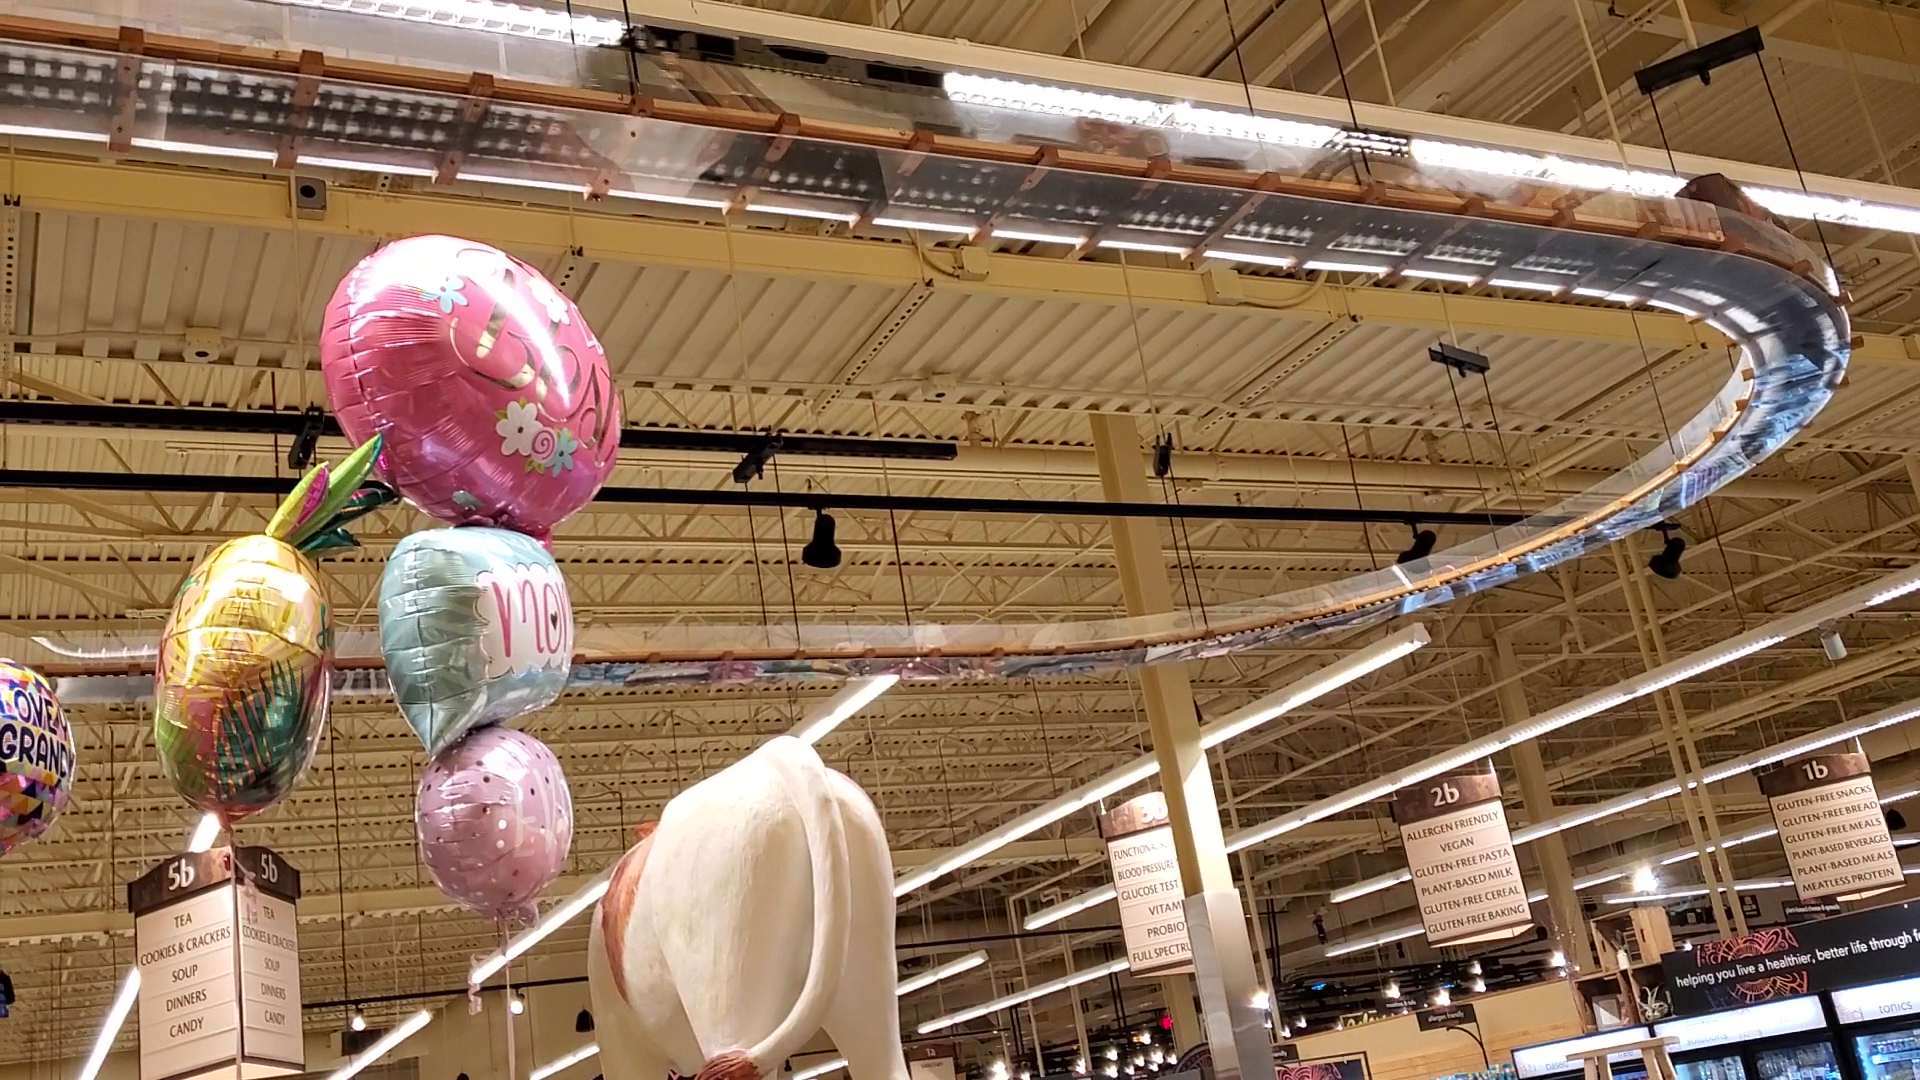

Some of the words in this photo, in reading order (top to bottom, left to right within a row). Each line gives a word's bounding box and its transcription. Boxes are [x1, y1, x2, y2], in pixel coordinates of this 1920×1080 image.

[0, 722, 74, 778] GRAND
[1802, 760, 1828, 780] 1b
[1430, 782, 1460, 807] 2b
[1777, 793, 1835, 812] GLUTEN-FREE
[1836, 784, 1872, 799] SNACKS
[1406, 823, 1453, 842] ALLERGEN
[1454, 811, 1499, 830] FRIENDLY
[1782, 809, 1844, 828] GLUTEN-FREE
[1845, 801, 1878, 815] BREAD
[1785, 825, 1848, 844] GLUTEN-FREE
[1849, 817, 1882, 832] MEALS
[1439, 837, 1475, 853] VEGAN
[1792, 842, 1844, 860] PLANT-BASED
[1845, 834, 1889, 849] BEVERAGES
[168, 858, 195, 891] 5b
[260, 853, 278, 883] 5b
[1118, 867, 1142, 881] BLOOD
[1142, 859, 1175, 875] PRESSURE
[1415, 855, 1477, 878] GLUTEN-FREE
[1479, 848, 1511, 862] PASTA
[1797, 857, 1861, 876] PLANT-BASED
[1862, 850, 1894, 864] MEALS
[1121, 883, 1158, 900] GLUCOSE
[1159, 880, 1179, 892] TEST
[1421, 873, 1487, 896] PLANT-BASED
[1487, 867, 1513, 881] MILK
[1802, 875, 1850, 893] MEATLESS
[1851, 868, 1895, 883] PROTEIN
[1148, 901, 1182, 916] VITAM
[1424, 893, 1484, 915] GLUTEN-FREE
[1485, 886, 1520, 901] CEREAL
[174, 912, 193, 929] TEA
[262, 906, 275, 921] TEA
[1428, 912, 1488, 934] GLUTEN-FREE
[1489, 904, 1526, 921] BAKING
[242, 925, 266, 943] COOKIES
[267, 933, 271, 944] &
[1147, 921, 1187, 938] PROBIO
[140, 944, 177, 966] COOKIES
[178, 942, 185, 953] &
[185, 926, 231, 950] CRACKERS
[1132, 950, 1153, 963] FULL
[1154, 942, 1192, 958] SPECTRU
[264, 957, 280, 972] SOUP
[1675, 970, 1715, 988] helping
[1715, 967, 1736, 984] you
[1738, 963, 1755, 976] live
[1757, 963, 1765, 972] a
[1765, 952, 1816, 971] healthier,
[1817, 946, 1849, 961] better
[1850, 941, 1868, 954] life
[1869, 931, 1913, 949] through
[172, 964, 198, 983] SOUP
[166, 989, 207, 1013] DINNERS
[261, 982, 286, 1000] DINNERS
[264, 1009, 285, 1026] CANDY
[1878, 1000, 1913, 1014] tonics
[169, 1016, 205, 1038] CANDY
